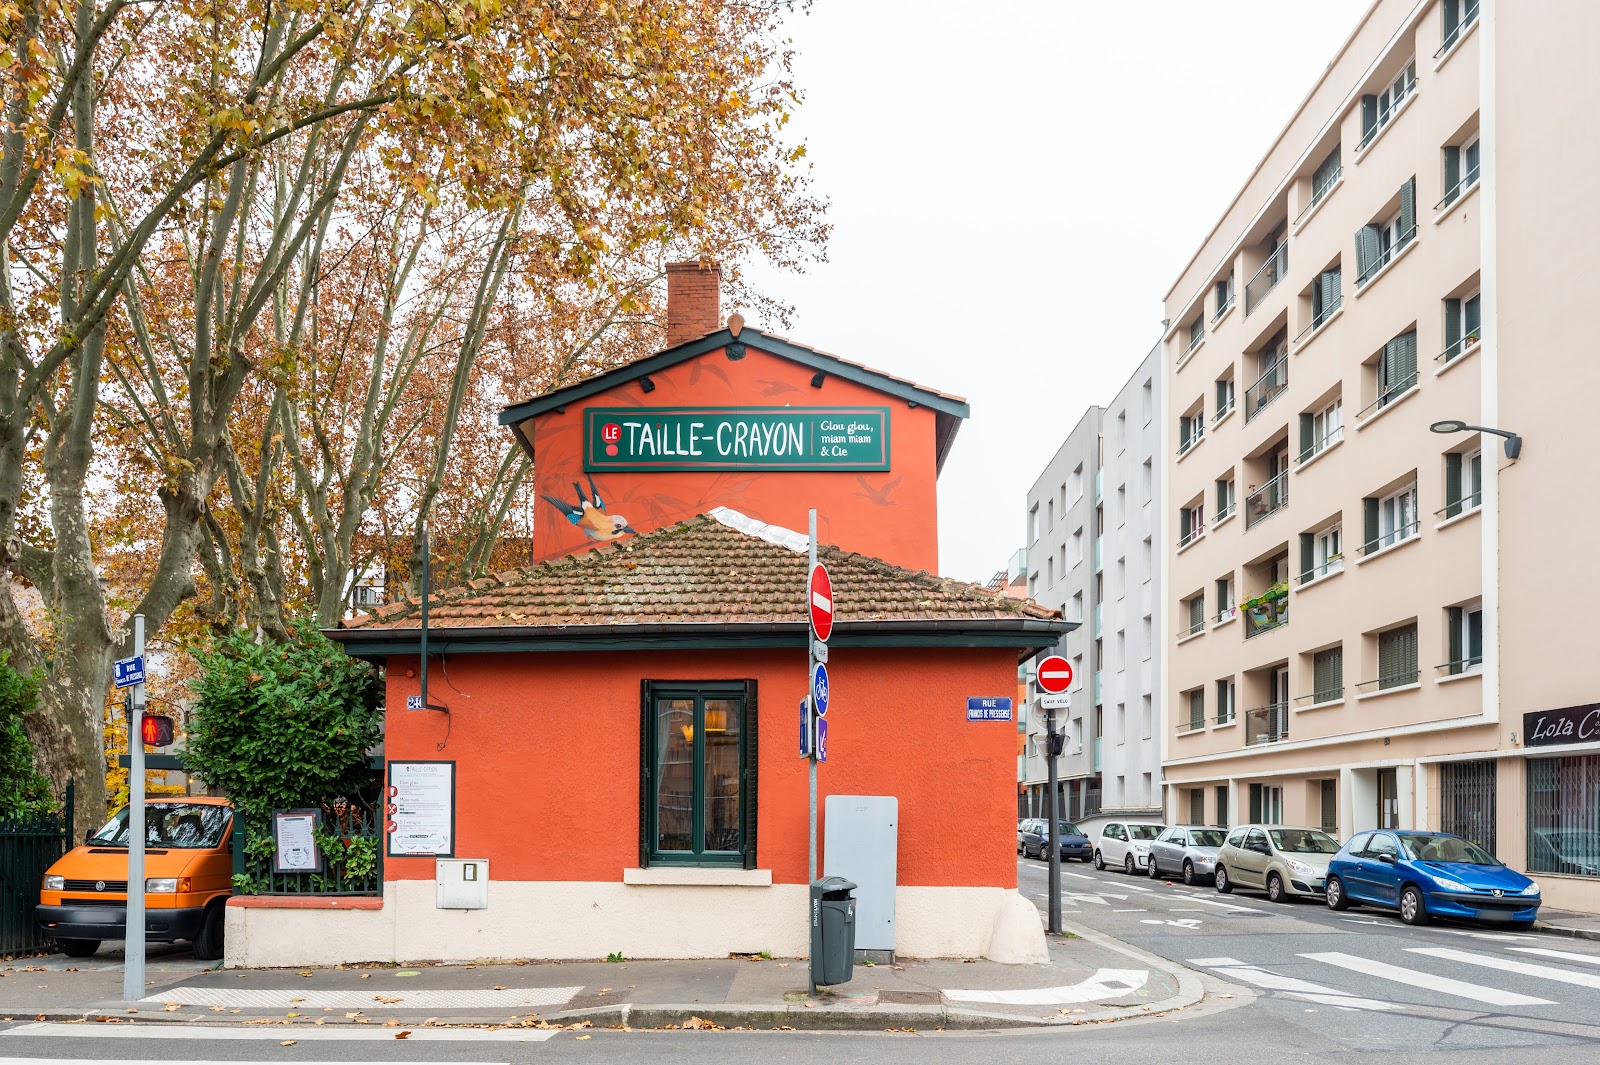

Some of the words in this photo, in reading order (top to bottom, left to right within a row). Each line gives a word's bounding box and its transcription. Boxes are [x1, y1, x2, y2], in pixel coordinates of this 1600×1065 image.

[605, 427, 618, 440] LE
[820, 420, 846, 431] Glou
[847, 420, 874, 435] glou,
[821, 434, 846, 443] miam
[848, 434, 871, 443] miam
[820, 446, 830, 457] &
[831, 445, 848, 457] Cie
[982, 699, 997, 708] RUE
